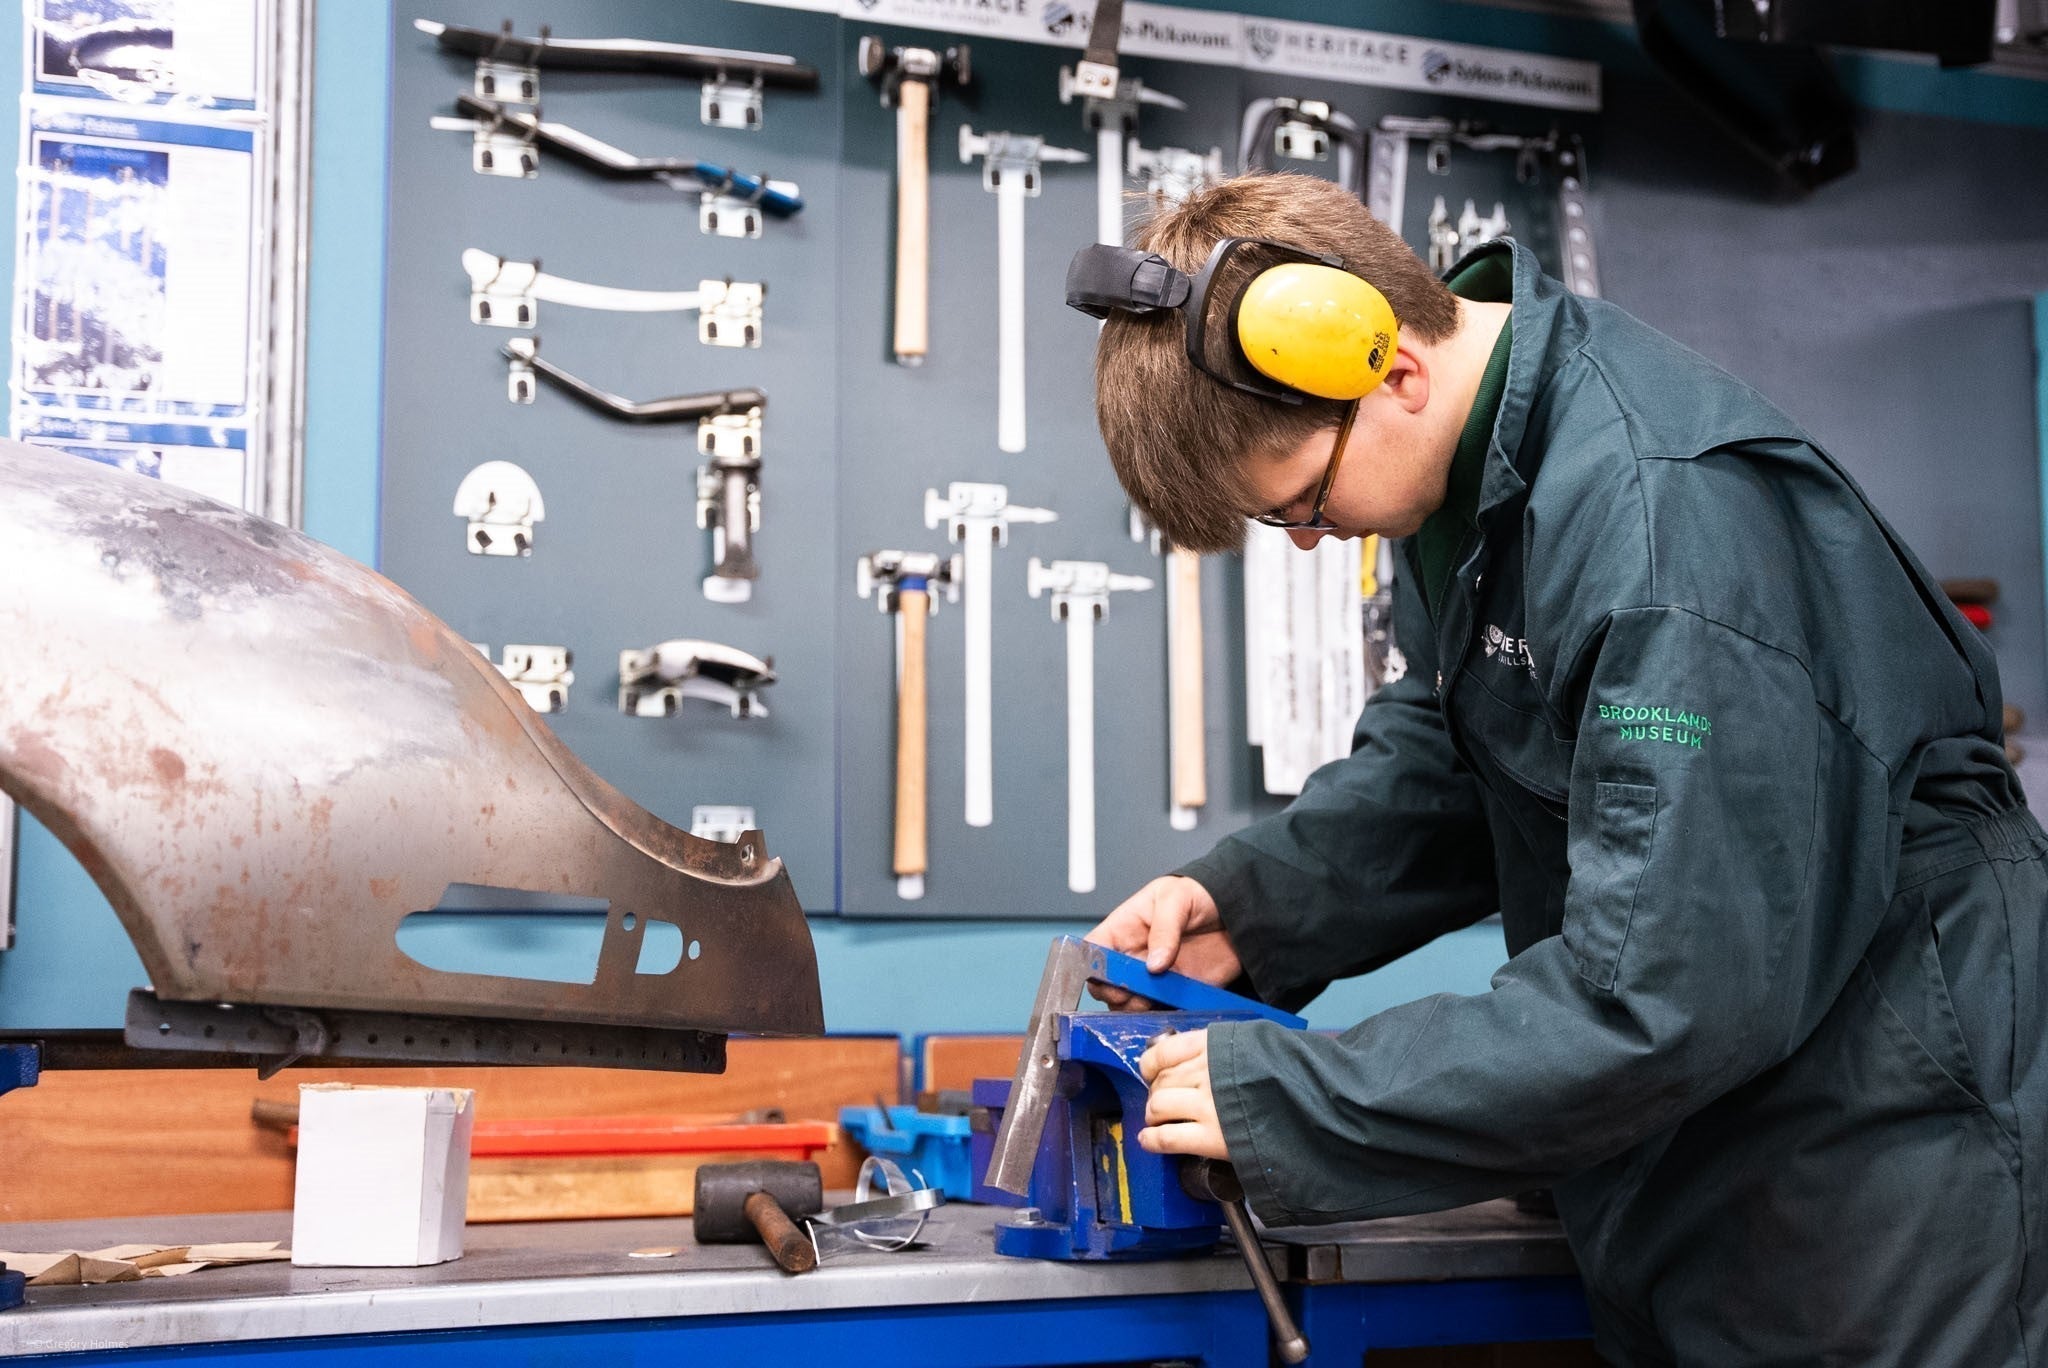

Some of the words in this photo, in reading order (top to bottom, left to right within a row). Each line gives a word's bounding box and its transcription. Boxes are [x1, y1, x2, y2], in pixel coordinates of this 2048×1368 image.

[1286, 33, 1409, 65] HERITAGE
[1599, 704, 1712, 735] BROOKLANDS
[1620, 725, 1702, 750] MUSEUM
